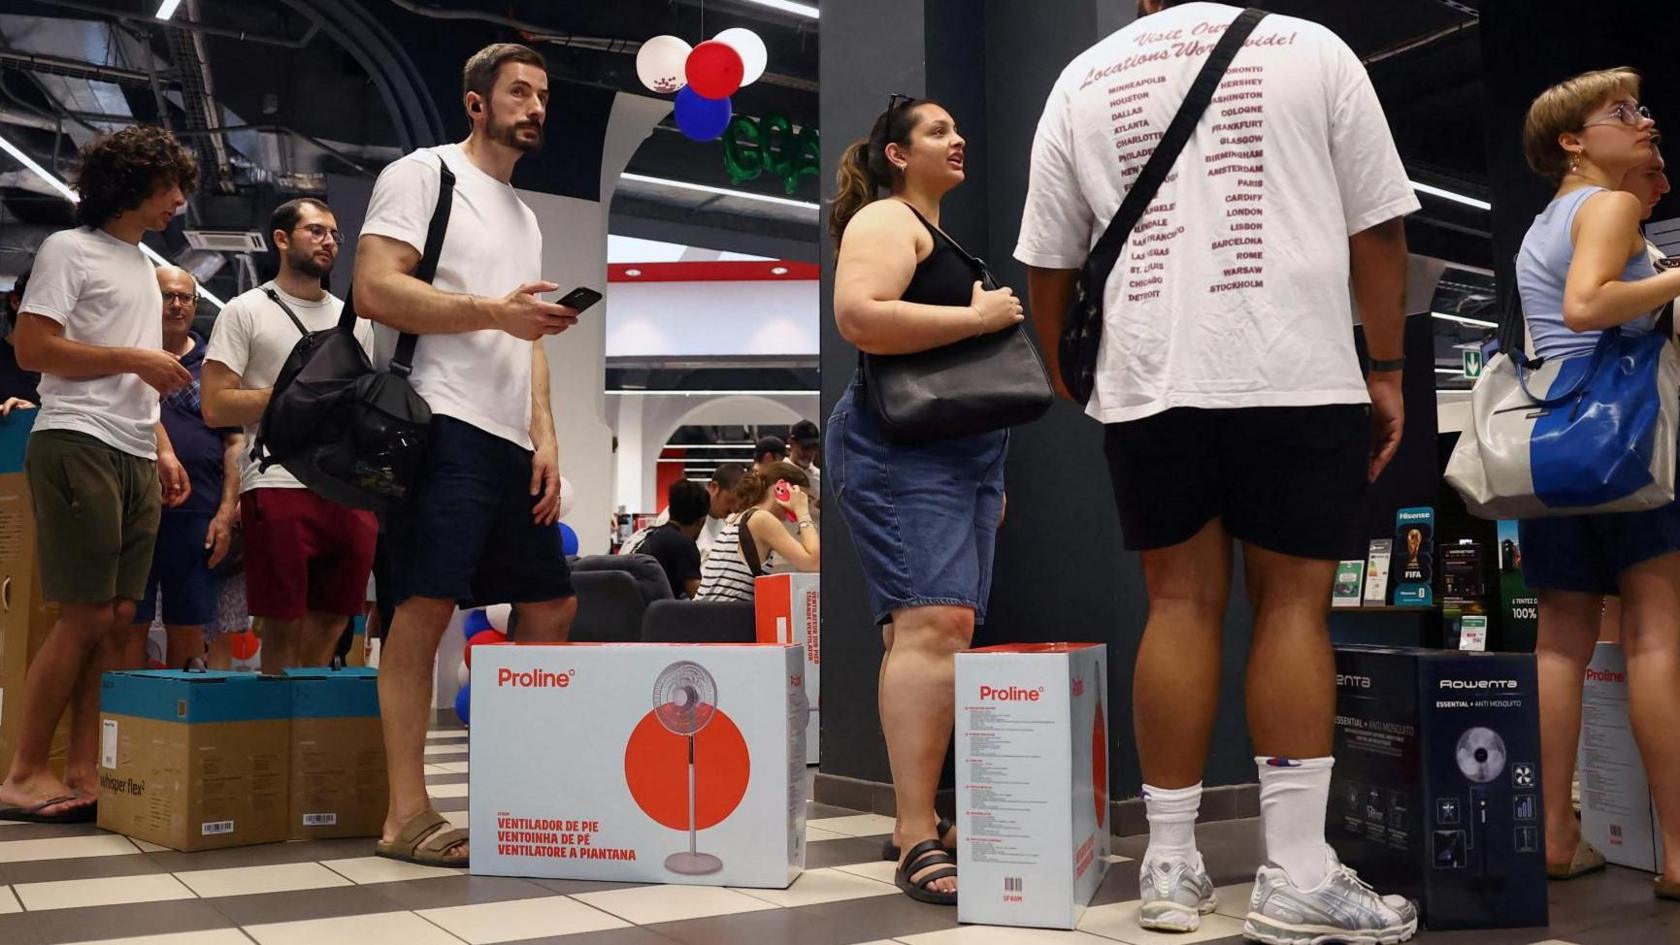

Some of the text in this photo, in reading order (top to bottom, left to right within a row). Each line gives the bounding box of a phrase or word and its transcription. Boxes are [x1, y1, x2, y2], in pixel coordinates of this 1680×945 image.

[1134, 22, 1230, 46] Visit Our
[1080, 50, 1170, 89] Locations
[1226, 66, 1263, 75] ORONTO
[1108, 76, 1166, 94] MINNEAPOLIS
[1220, 79, 1263, 88] HERSHEY
[1110, 92, 1149, 107] HOUSTON
[1212, 92, 1263, 103] ASHINGTON
[1112, 106, 1143, 121] DALLAS
[1221, 105, 1263, 117] COLOGNE
[1114, 119, 1149, 134] ATLANTA
[1212, 120, 1263, 134] FRANKFURT
[1220, 135, 1263, 145] GLASGOW
[1205, 149, 1263, 162] BIRMINGHAM
[1121, 165, 1140, 177] NEW
[1208, 164, 1263, 176] AMSTERDAM
[1237, 179, 1263, 187] PARIS
[1225, 194, 1263, 202] CARDIFF
[1226, 208, 1263, 217] LONDON
[1230, 223, 1263, 231] LISBON
[1211, 237, 1263, 250] BARCELONA
[1236, 252, 1263, 260] ROME
[1223, 267, 1263, 277] WARSAW
[1129, 276, 1163, 288] CHICAGO
[1210, 280, 1264, 293] STOCKHOLM
[1128, 290, 1160, 301] DETROIT
[1512, 607, 1537, 619] 100%
[1335, 716, 1363, 728] SSENTIAL
[498, 817, 598, 832] VENTILADOR DE PIE
[498, 831, 590, 845] VENTOINHA DE PÉ
[498, 844, 636, 860] VENTILATORE A PIANTANA
